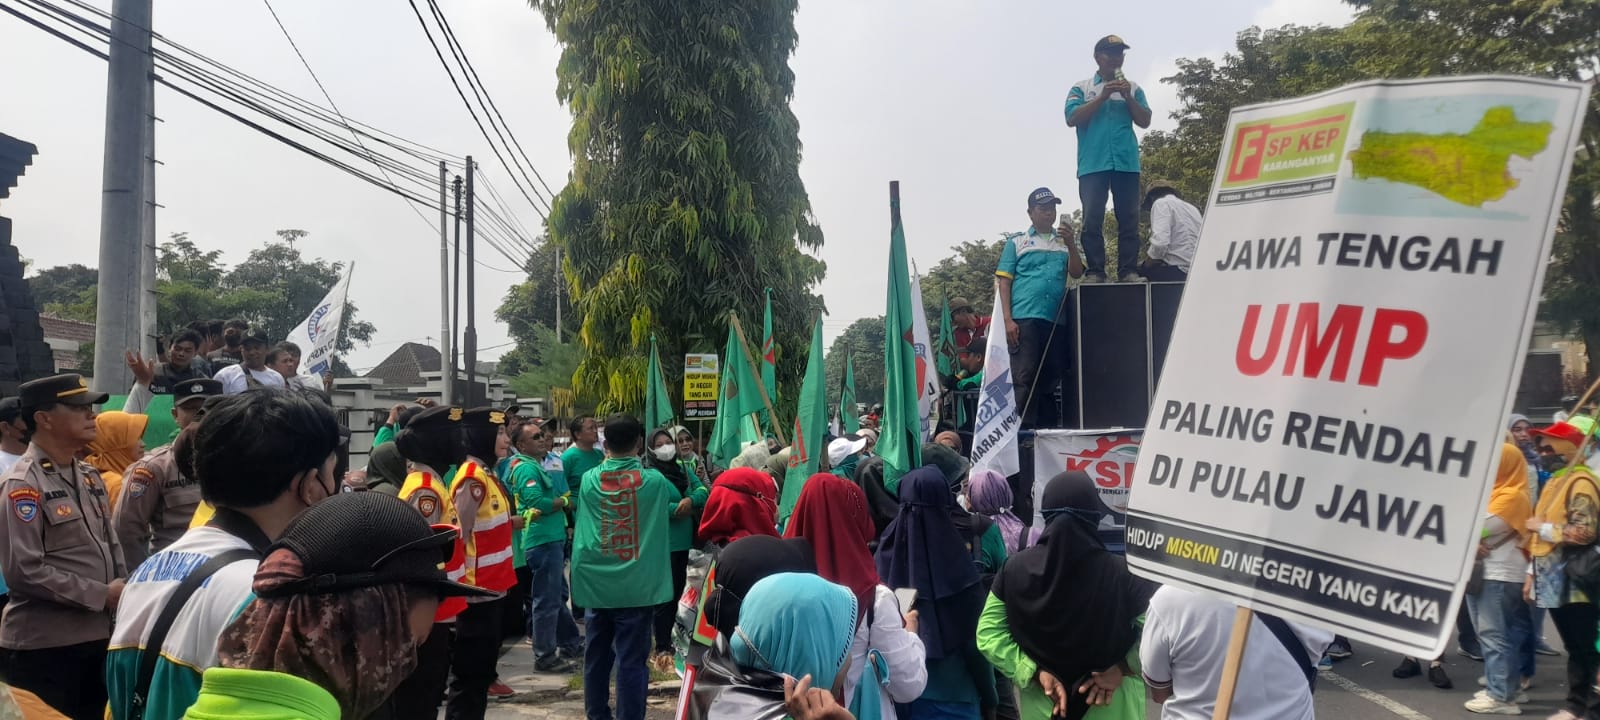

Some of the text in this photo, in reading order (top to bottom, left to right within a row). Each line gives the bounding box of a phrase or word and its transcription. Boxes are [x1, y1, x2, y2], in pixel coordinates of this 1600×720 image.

[1231, 126, 1340, 179] F SP KEP
[1263, 153, 1336, 172] KARANGANYAR
[1216, 232, 1504, 276] JAWA TENGAH
[1235, 302, 1429, 387] UMP
[1159, 400, 1477, 478] PALING RENDAH
[1148, 454, 1446, 545] DI PULAU JAWA
[1127, 526, 1440, 624] HIDUP MISKIN DI NEGERI YANG KAYA
